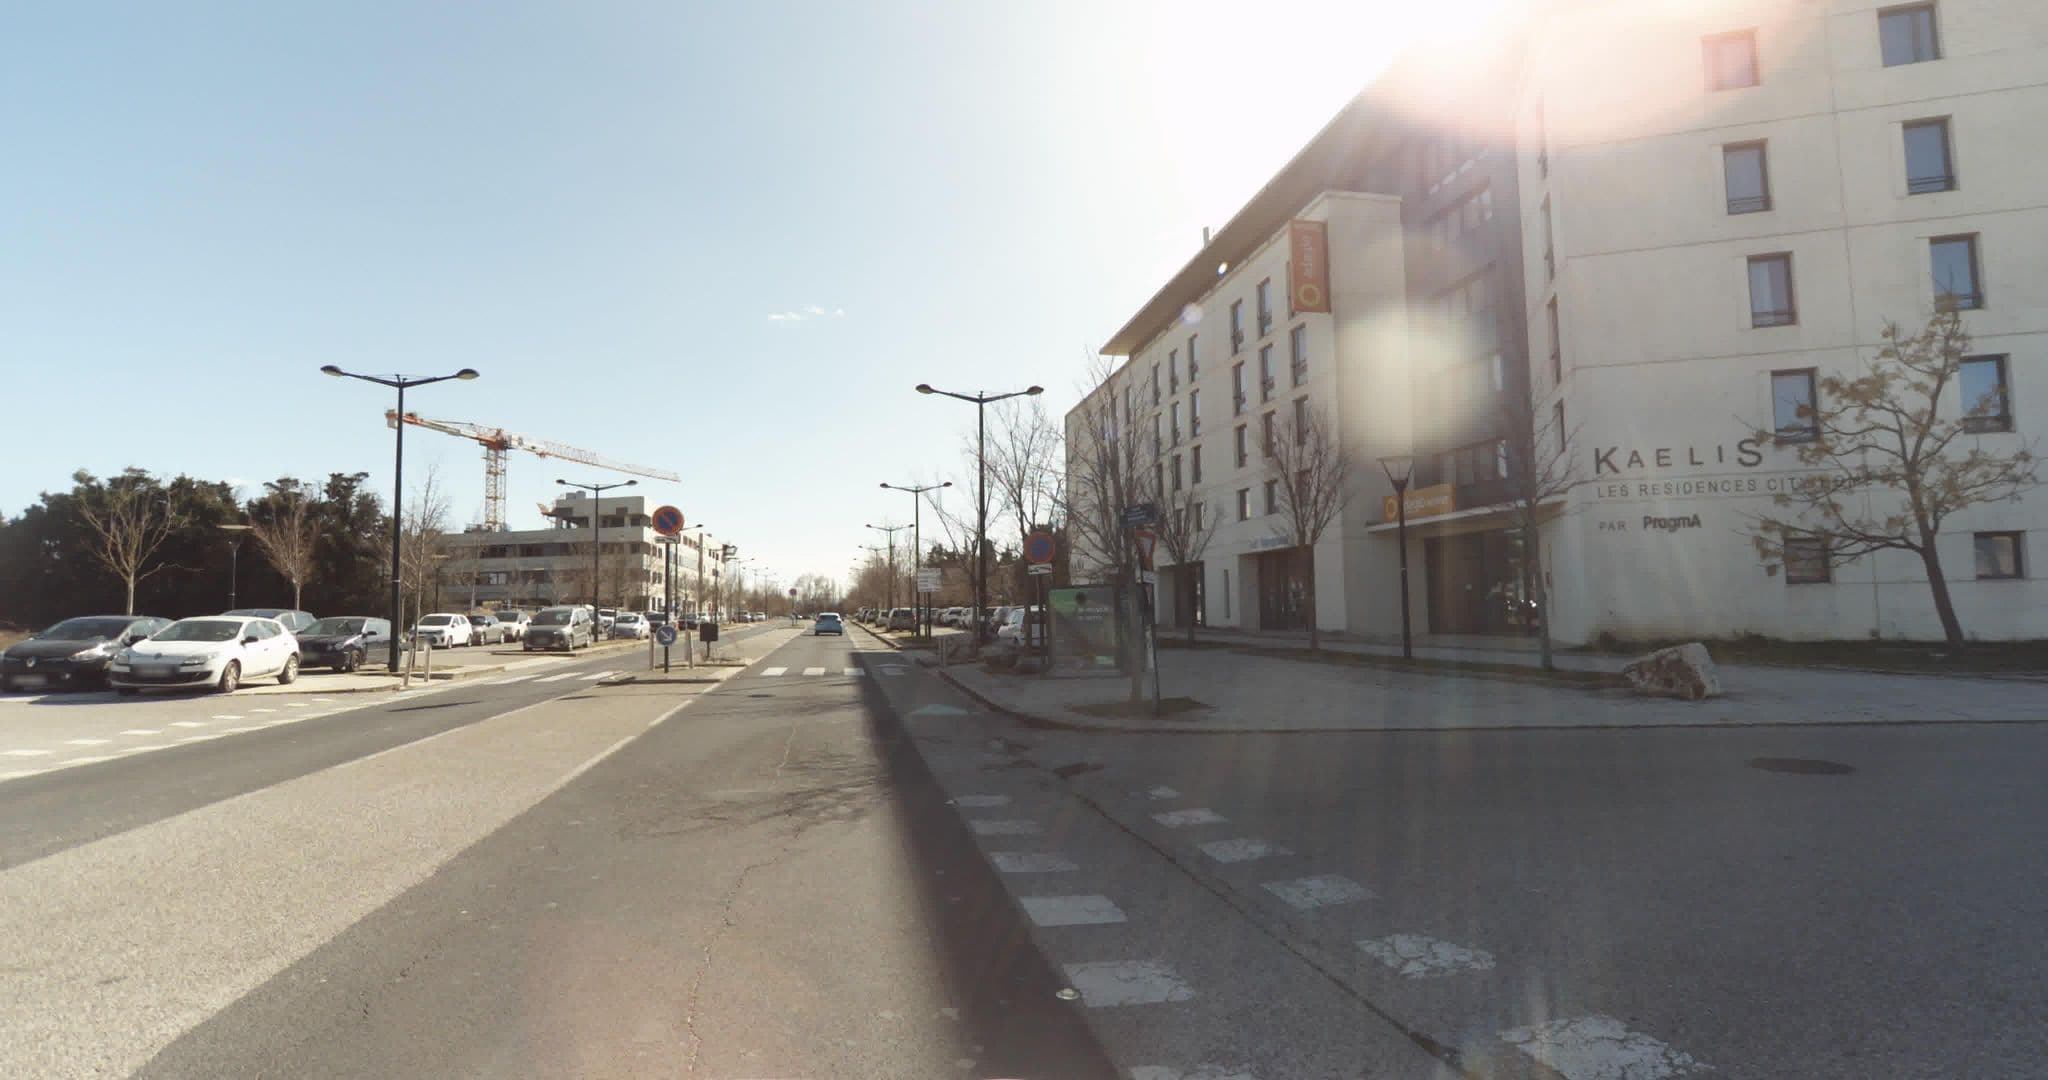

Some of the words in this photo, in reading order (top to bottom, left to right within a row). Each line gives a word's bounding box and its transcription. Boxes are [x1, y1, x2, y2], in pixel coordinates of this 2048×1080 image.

[1594, 438, 1763, 475] KAELIS
[1598, 484, 1629, 498] LES
[1639, 478, 1757, 497] RESIDENCES
[1599, 520, 1627, 532] PAR
[1643, 513, 1702, 533] PragmA
